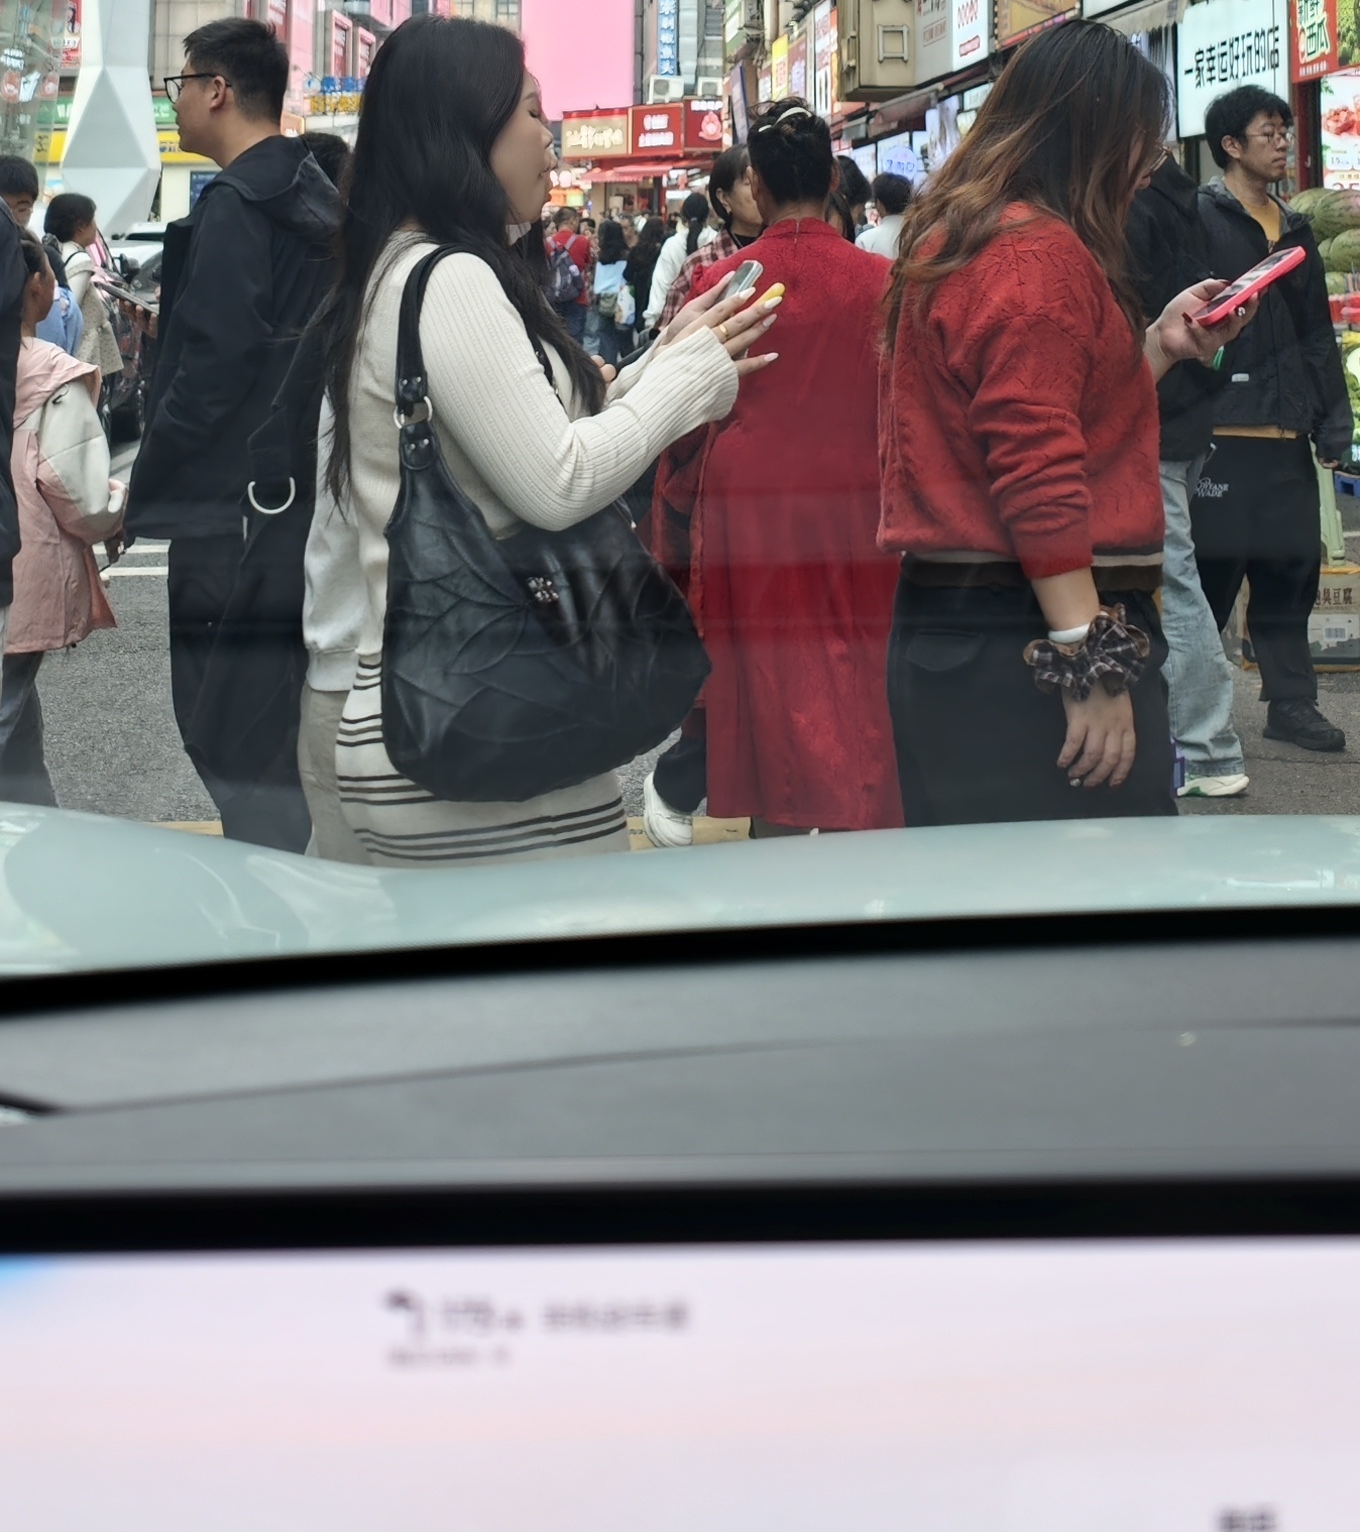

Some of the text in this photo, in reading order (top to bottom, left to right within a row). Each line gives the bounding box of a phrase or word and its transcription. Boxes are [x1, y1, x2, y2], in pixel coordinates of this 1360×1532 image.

[1184, 25, 1280, 89] 一家幸运好玩的店
[1306, 18, 1330, 59] 西瓜
